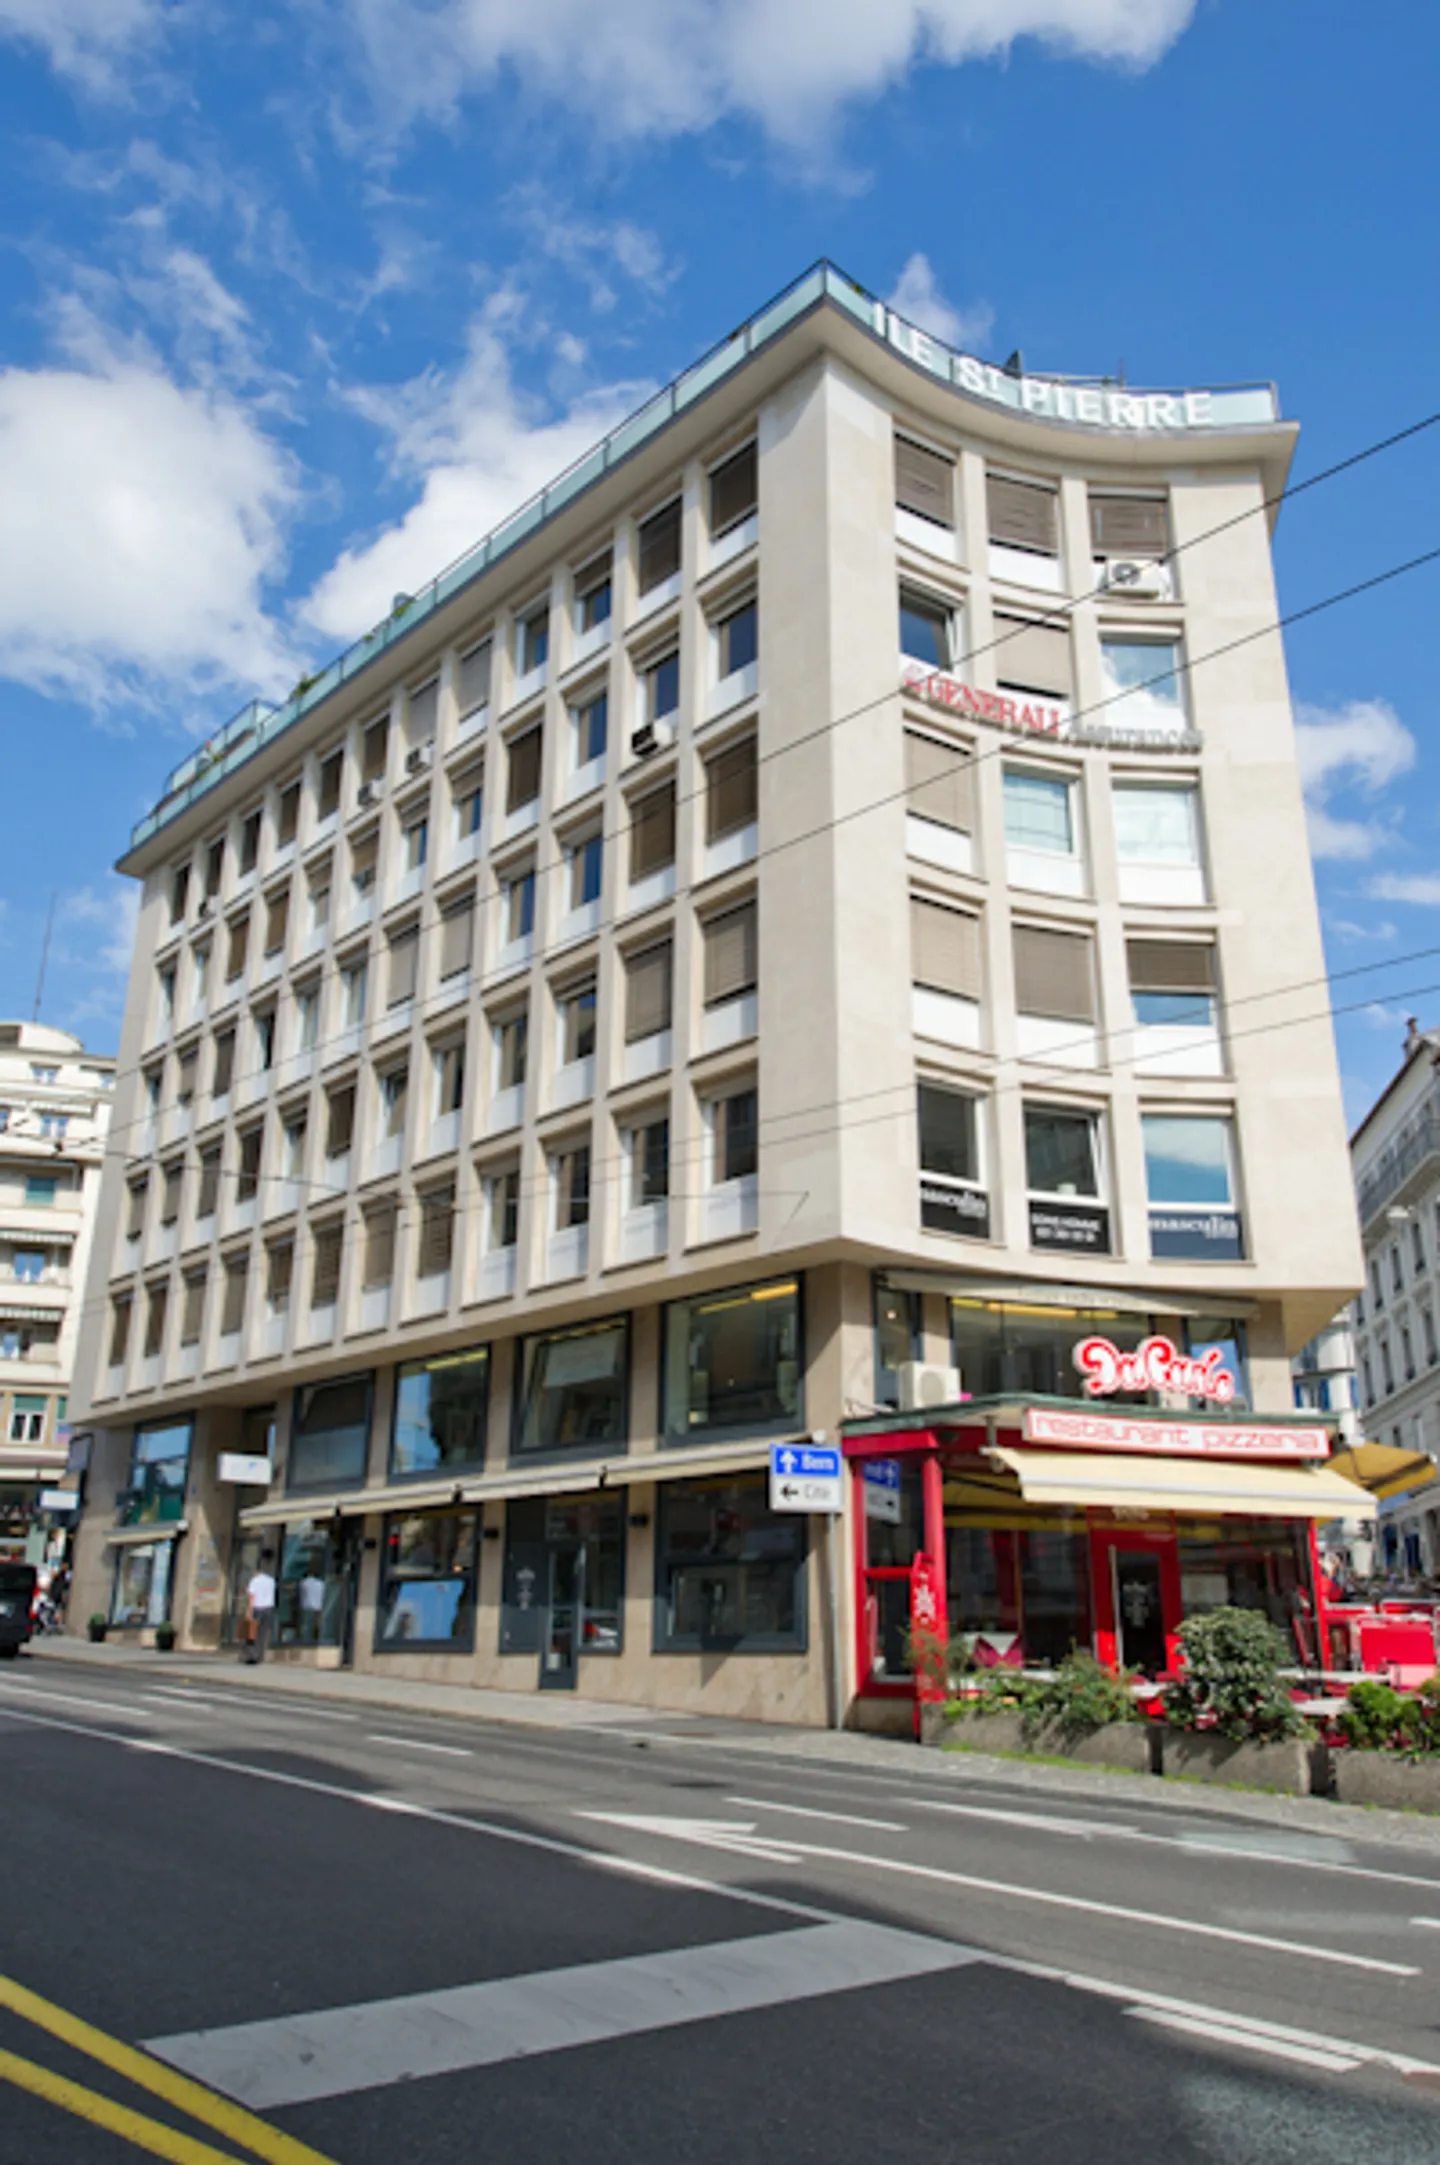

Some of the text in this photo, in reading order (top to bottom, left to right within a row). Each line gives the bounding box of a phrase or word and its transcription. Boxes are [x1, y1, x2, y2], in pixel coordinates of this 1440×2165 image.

[873, 302, 935, 368] ILE
[1021, 378, 1215, 428] PIERRE
[927, 675, 1060, 735] GENERALI
[1147, 1215, 1238, 1233] masculin
[1036, 1417, 1319, 1450] restaurant pizzeria
